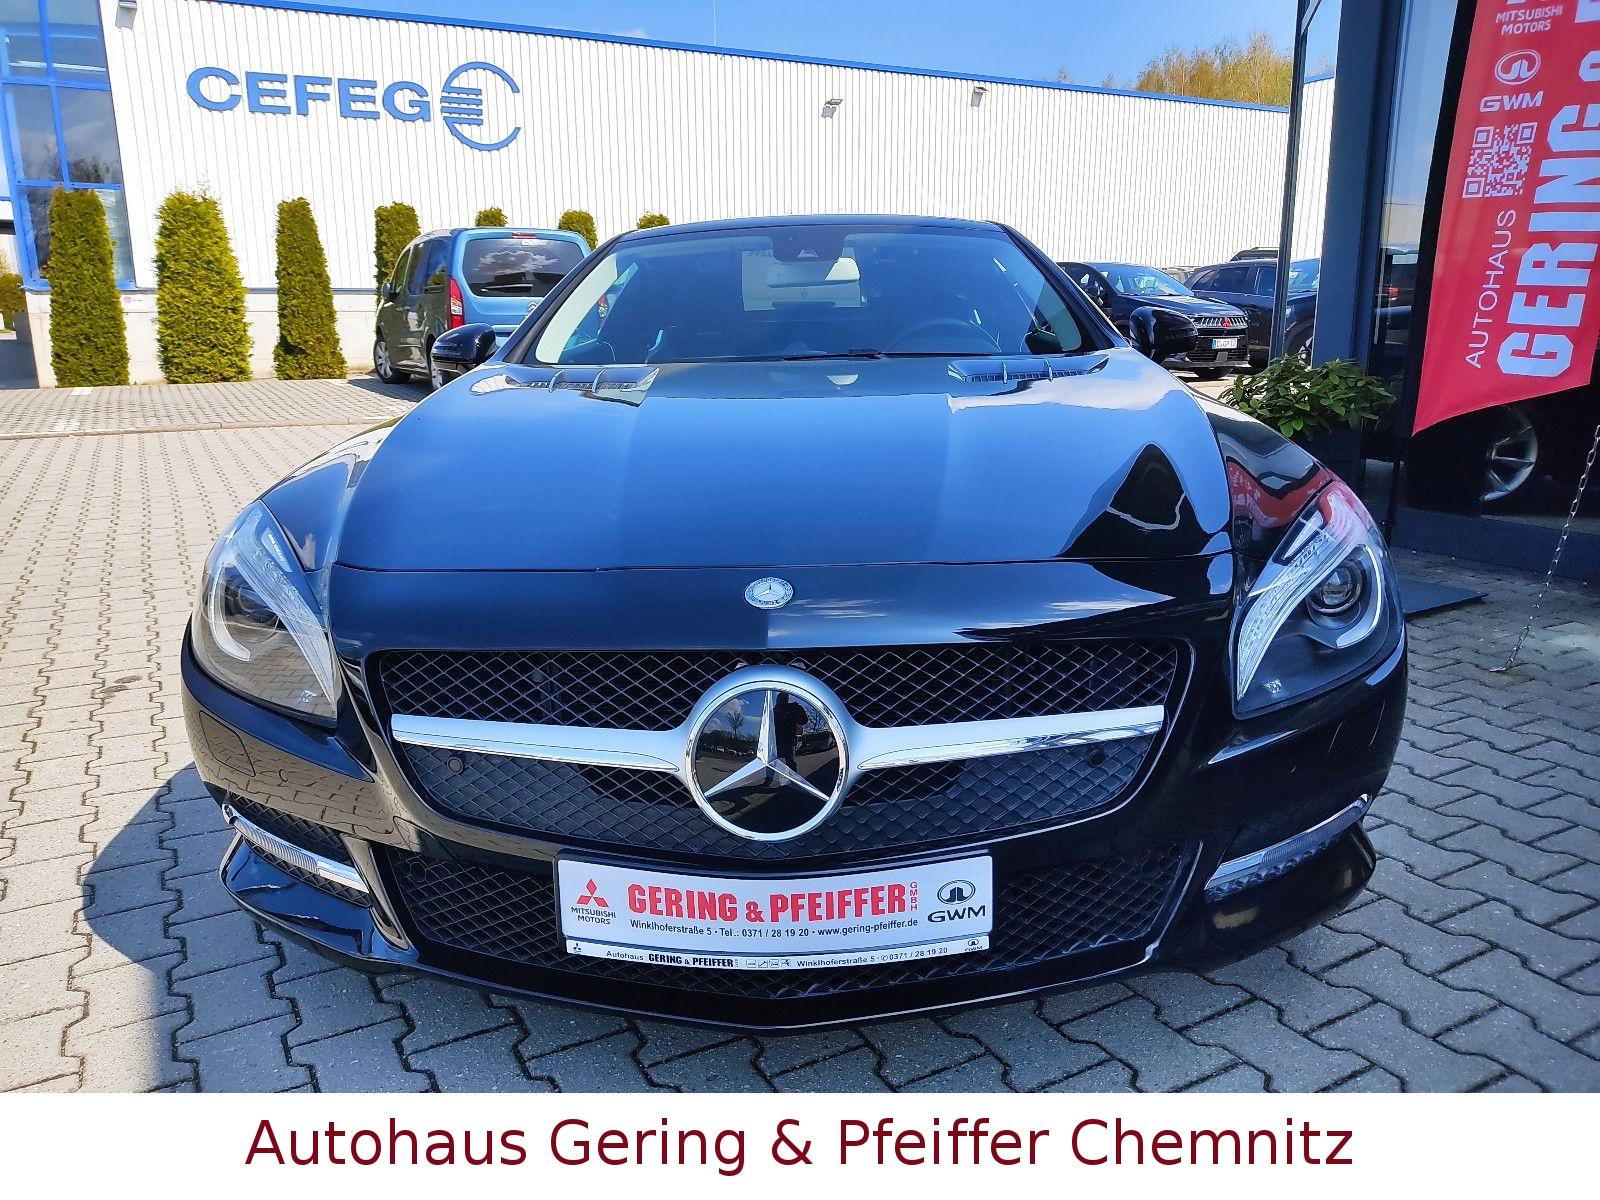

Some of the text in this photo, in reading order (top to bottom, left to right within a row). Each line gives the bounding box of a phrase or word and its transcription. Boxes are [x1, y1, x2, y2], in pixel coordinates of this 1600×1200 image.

[1495, 5, 1563, 23] MITSUBISHI
[1500, 19, 1551, 35] MOTORS
[186, 66, 431, 122] CEFEG
[1480, 91, 1544, 112] GWM
[1497, 103, 1600, 378] GERING
[1465, 209, 1517, 369] AUTOHAUS
[627, 883, 906, 923] GERING & PFEIFFER
[909, 881, 918, 912] GMBH
[571, 906, 617, 919] MITSUBISHI
[577, 915, 611, 925] MOTORS
[927, 904, 986, 923] GWM
[630, 918, 704, 936] Winklhoferstraße
[706, 927, 712, 936] 5
[741, 928, 763, 938] 0371
[771, 928, 782, 938] 28
[785, 928, 796, 937] 19
[798, 928, 809, 937] 20
[817, 918, 918, 936] www.gering-pfeiffer.de
[606, 950, 644, 961] Autohaus
[648, 953, 682, 965] GERING
[692, 957, 734, 968] PFEIFFER
[796, 956, 868, 968] Winklhoferstraße
[889, 952, 908, 961] 0371
[926, 948, 936, 956] 19
